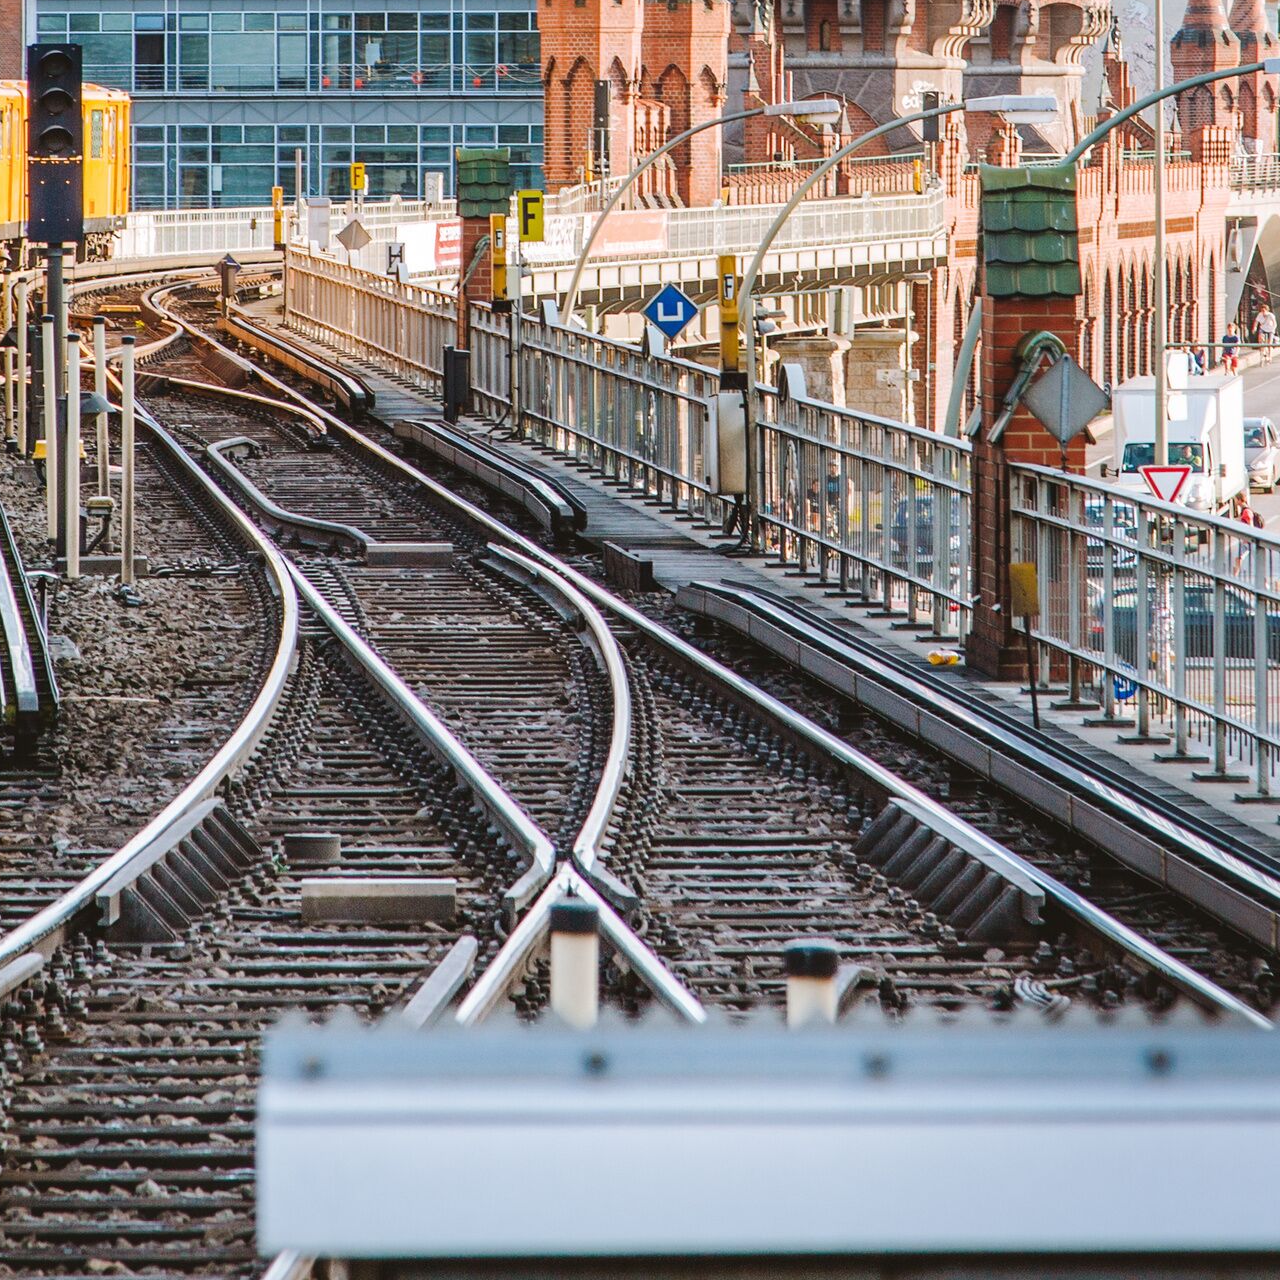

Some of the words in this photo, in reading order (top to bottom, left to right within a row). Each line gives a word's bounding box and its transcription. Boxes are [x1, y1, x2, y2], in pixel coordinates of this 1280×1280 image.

[354, 166, 362, 186] F
[522, 197, 540, 235] F
[495, 230, 502, 246] F
[388, 245, 403, 269] H
[724, 275, 733, 298] F
